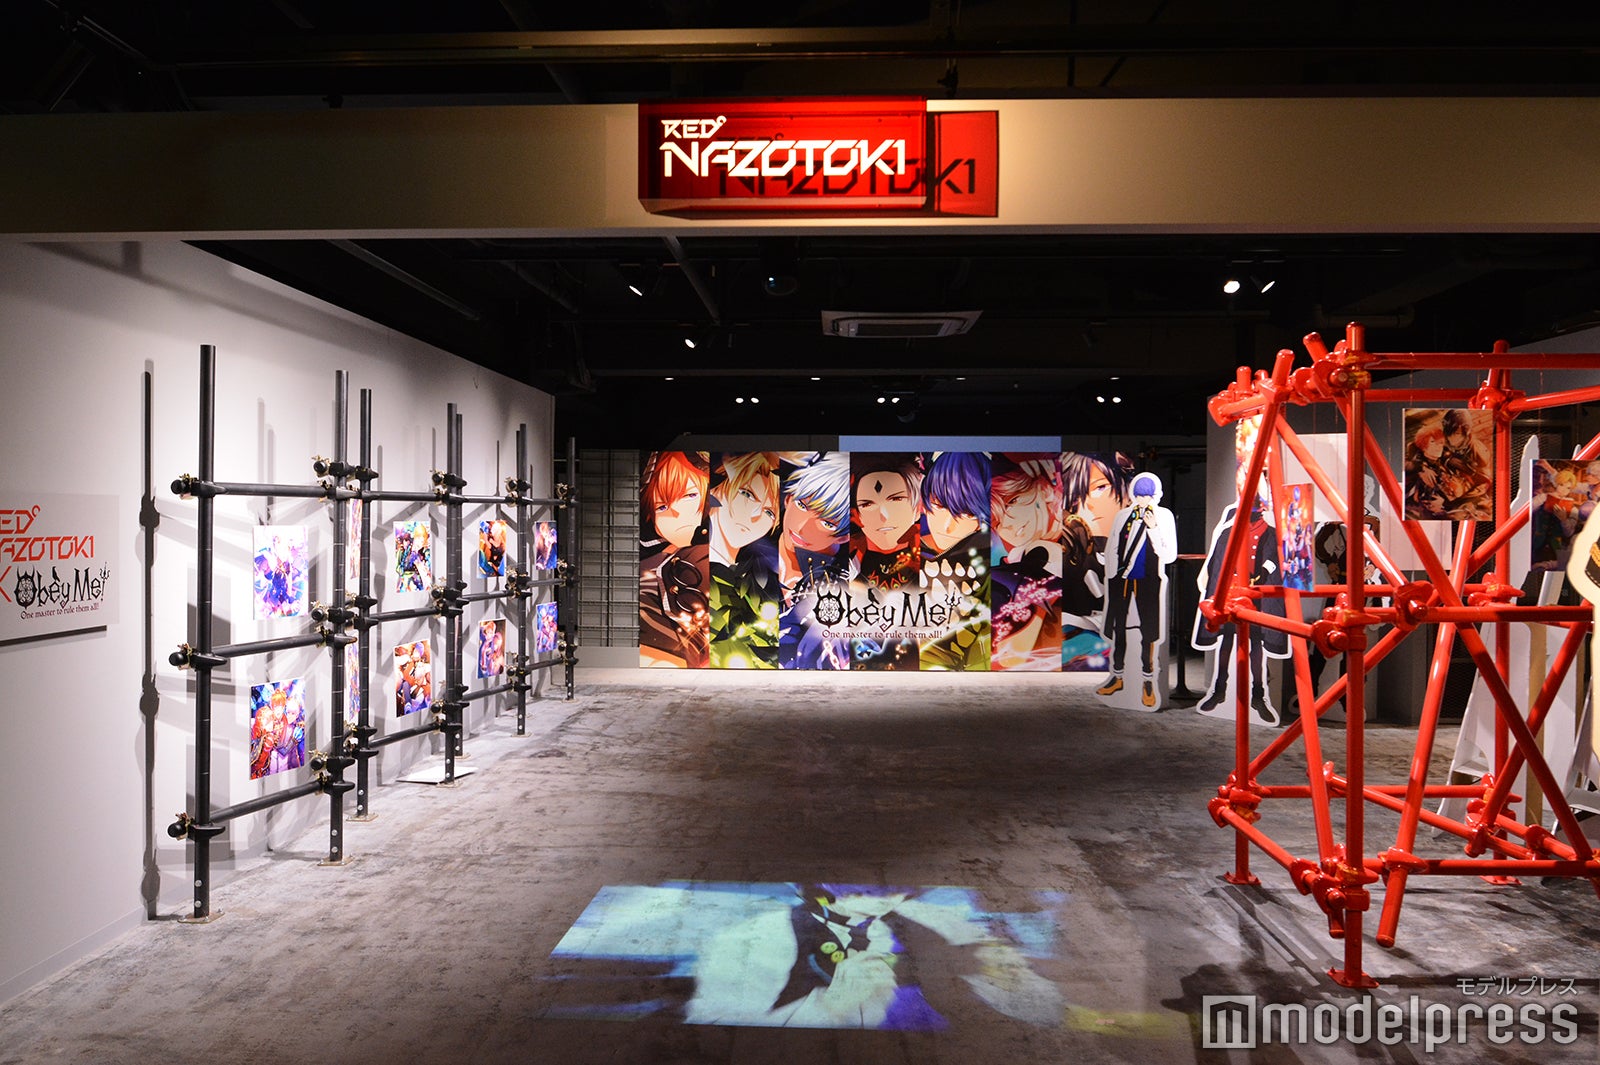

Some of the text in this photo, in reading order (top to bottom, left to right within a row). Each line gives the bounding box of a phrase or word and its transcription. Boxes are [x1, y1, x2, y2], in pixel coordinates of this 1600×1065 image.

[14, 565, 71, 610] Obey
[20, 611, 34, 620] One
[35, 609, 56, 618] master
[64, 606, 75, 614] rule
[75, 604, 90, 613] them
[812, 586, 896, 632] Obey
[822, 629, 840, 638] One
[885, 630, 902, 638] rule
[905, 630, 927, 638] them
[928, 630, 942, 638] all!
